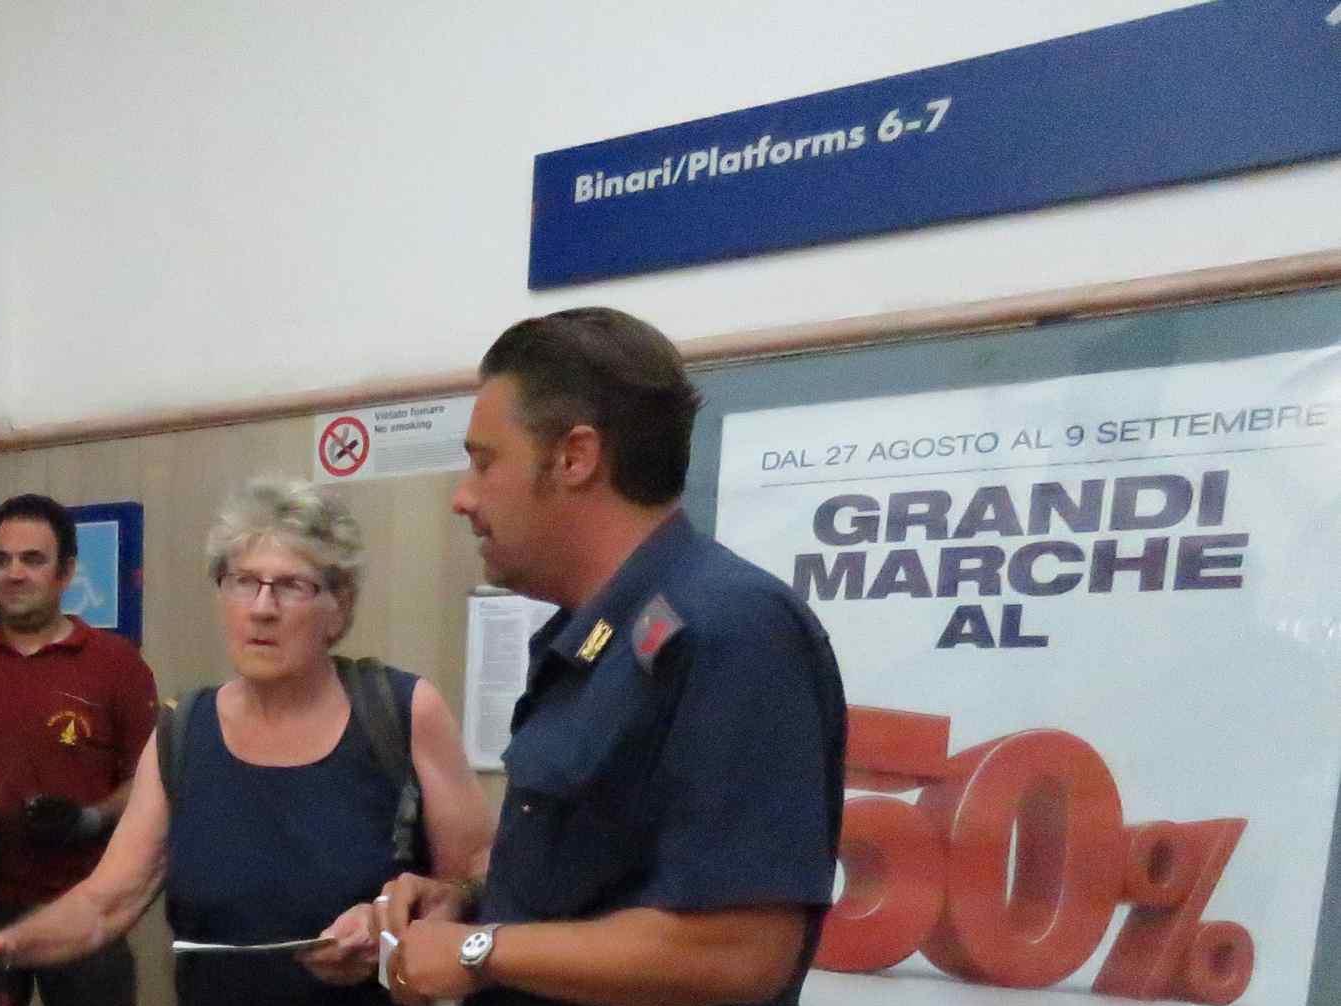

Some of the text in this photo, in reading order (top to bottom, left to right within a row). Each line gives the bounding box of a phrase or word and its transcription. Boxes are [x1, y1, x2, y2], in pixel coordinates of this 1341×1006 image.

[574, 97, 952, 203] Binari/Platforms 6-7
[761, 403, 1330, 471] DAL 27 AGOSTO AL 9 SETTEMBRE
[813, 470, 1230, 547] GRANDI
[792, 532, 1250, 601] MARCHE
[934, 603, 1050, 649] AL
